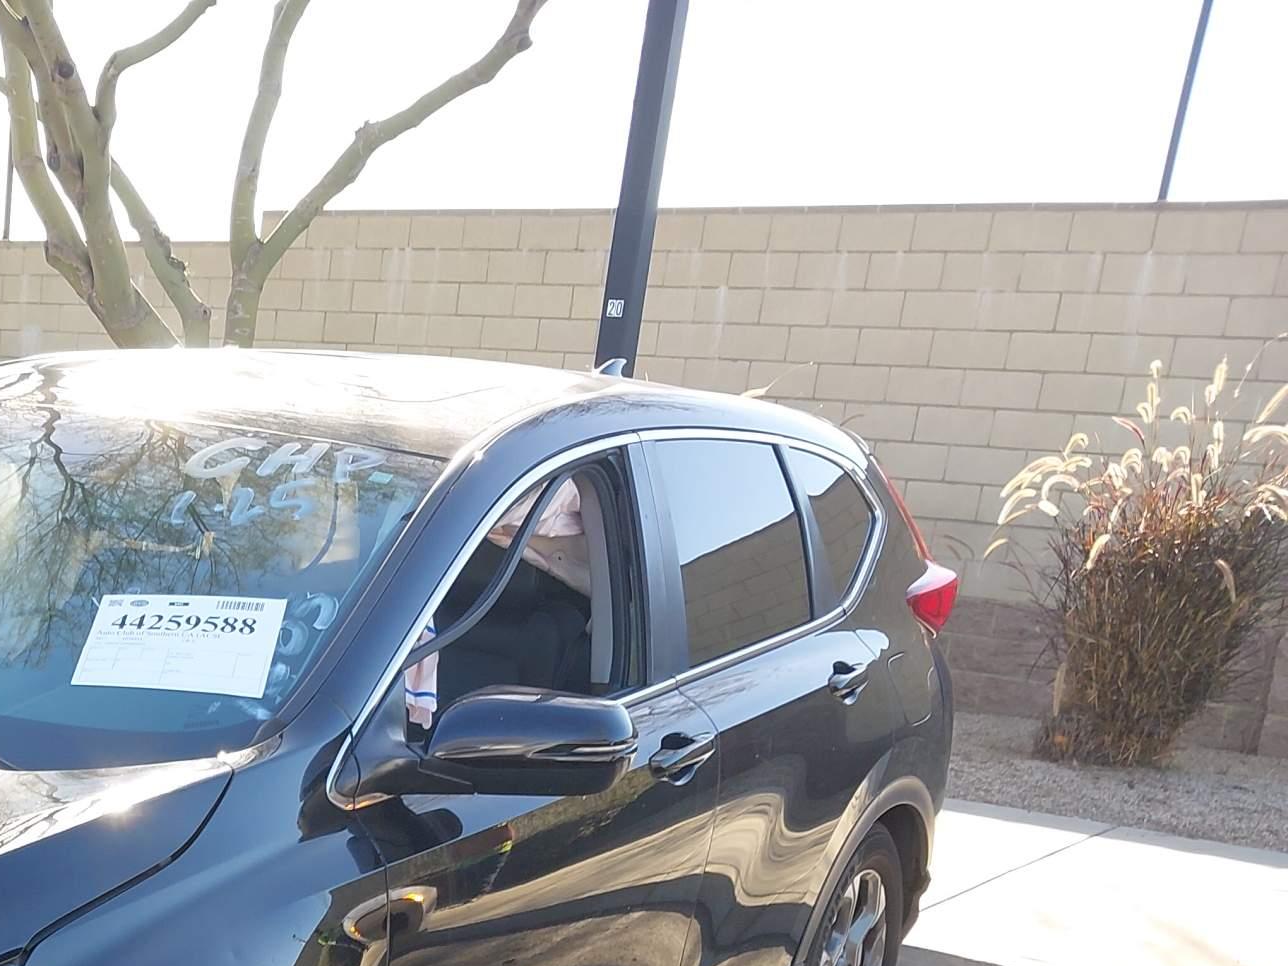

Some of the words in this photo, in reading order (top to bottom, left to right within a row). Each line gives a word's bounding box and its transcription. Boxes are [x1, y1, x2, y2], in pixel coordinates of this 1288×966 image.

[608, 301, 623, 316] 20
[183, 436, 386, 484] CHP
[111, 613, 257, 636] 44259588
